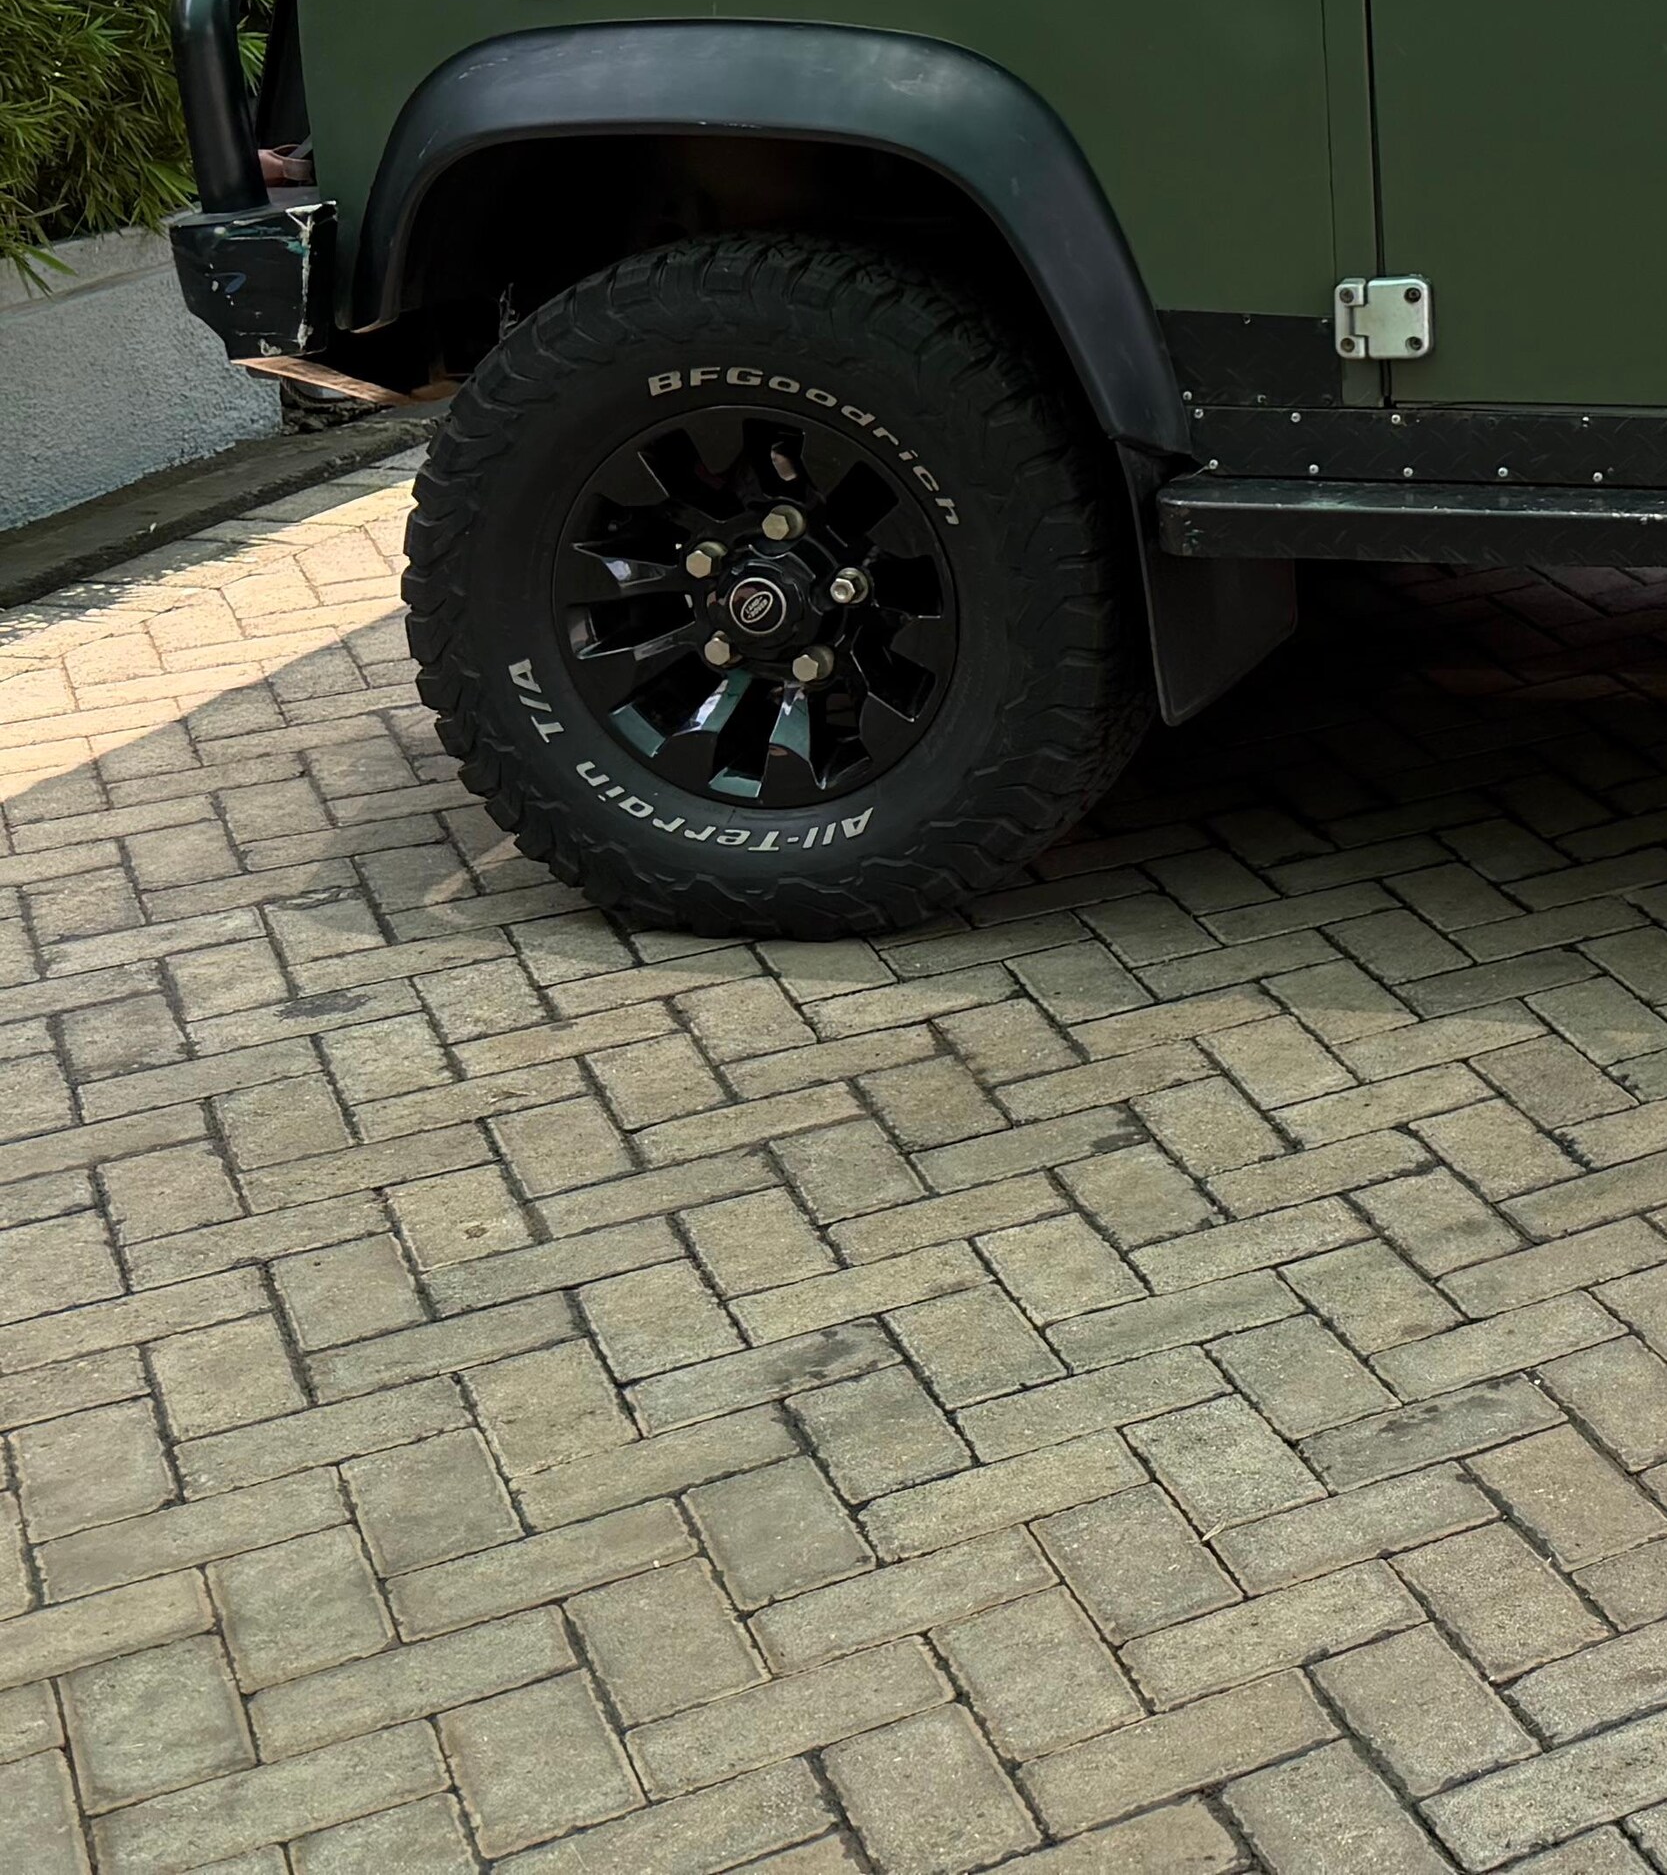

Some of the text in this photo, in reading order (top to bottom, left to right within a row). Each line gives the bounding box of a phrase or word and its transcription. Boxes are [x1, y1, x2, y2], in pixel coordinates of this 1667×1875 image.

[648, 366, 960, 526] BFGoodrich
[508, 657, 875, 854] All-Terrain T/A
